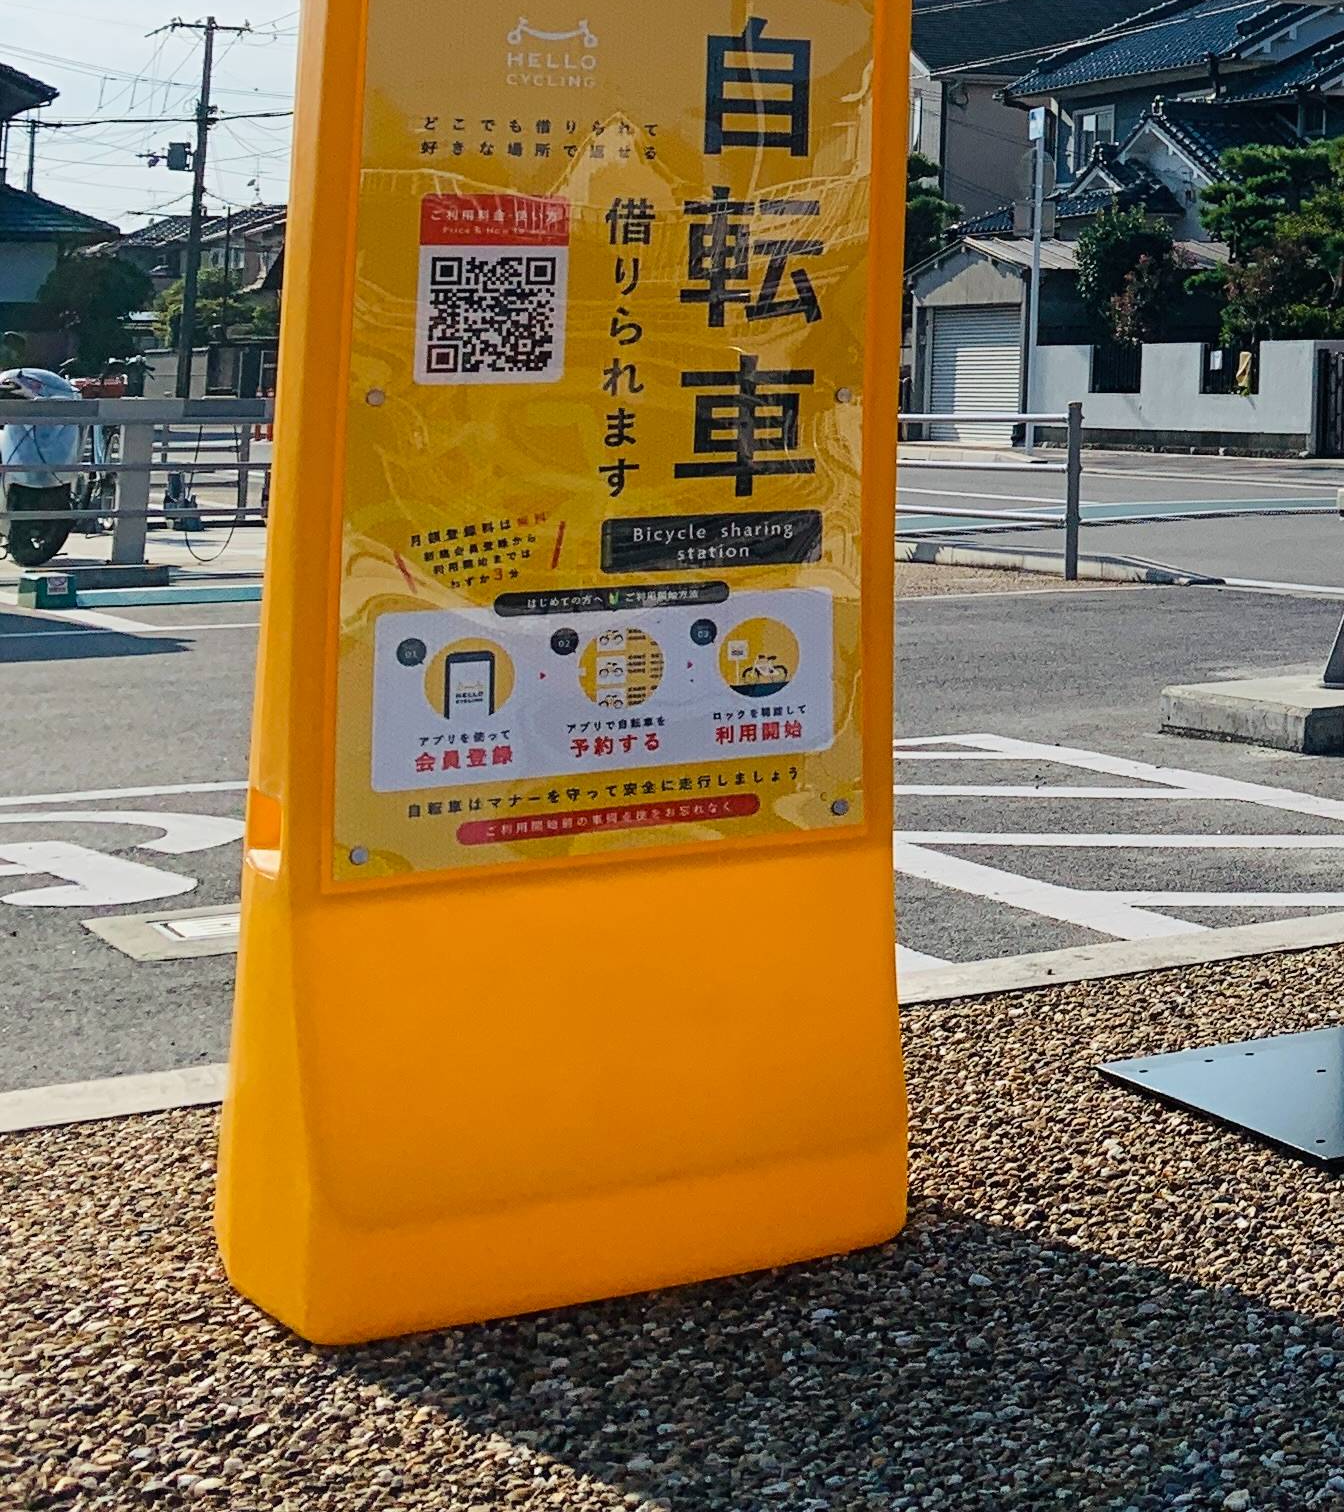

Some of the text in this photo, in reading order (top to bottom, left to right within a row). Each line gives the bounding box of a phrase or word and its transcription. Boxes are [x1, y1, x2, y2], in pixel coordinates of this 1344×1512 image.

[506, 51, 597, 70] HELLO
[506, 73, 596, 88] CYCLING
[423, 116, 659, 137] どこでも借りられて
[420, 140, 657, 160] 好きな場所で返せる
[674, 16, 823, 496] 自転車
[598, 196, 656, 498] 借りられます
[632, 521, 794, 545] Bicycle sharing
[677, 543, 750, 562] station
[527, 595, 603, 609] はじめての方へ
[557, 639, 571, 648] 02
[566, 716, 665, 734] アプリで自転車を
[715, 720, 803, 746] 利用開始
[419, 729, 511, 747] アプリを使って
[570, 732, 660, 758] 予約する
[415, 745, 513, 773] 会員登録
[407, 766, 799, 818] 自転車はマナーを守って安全に走行しましょう
